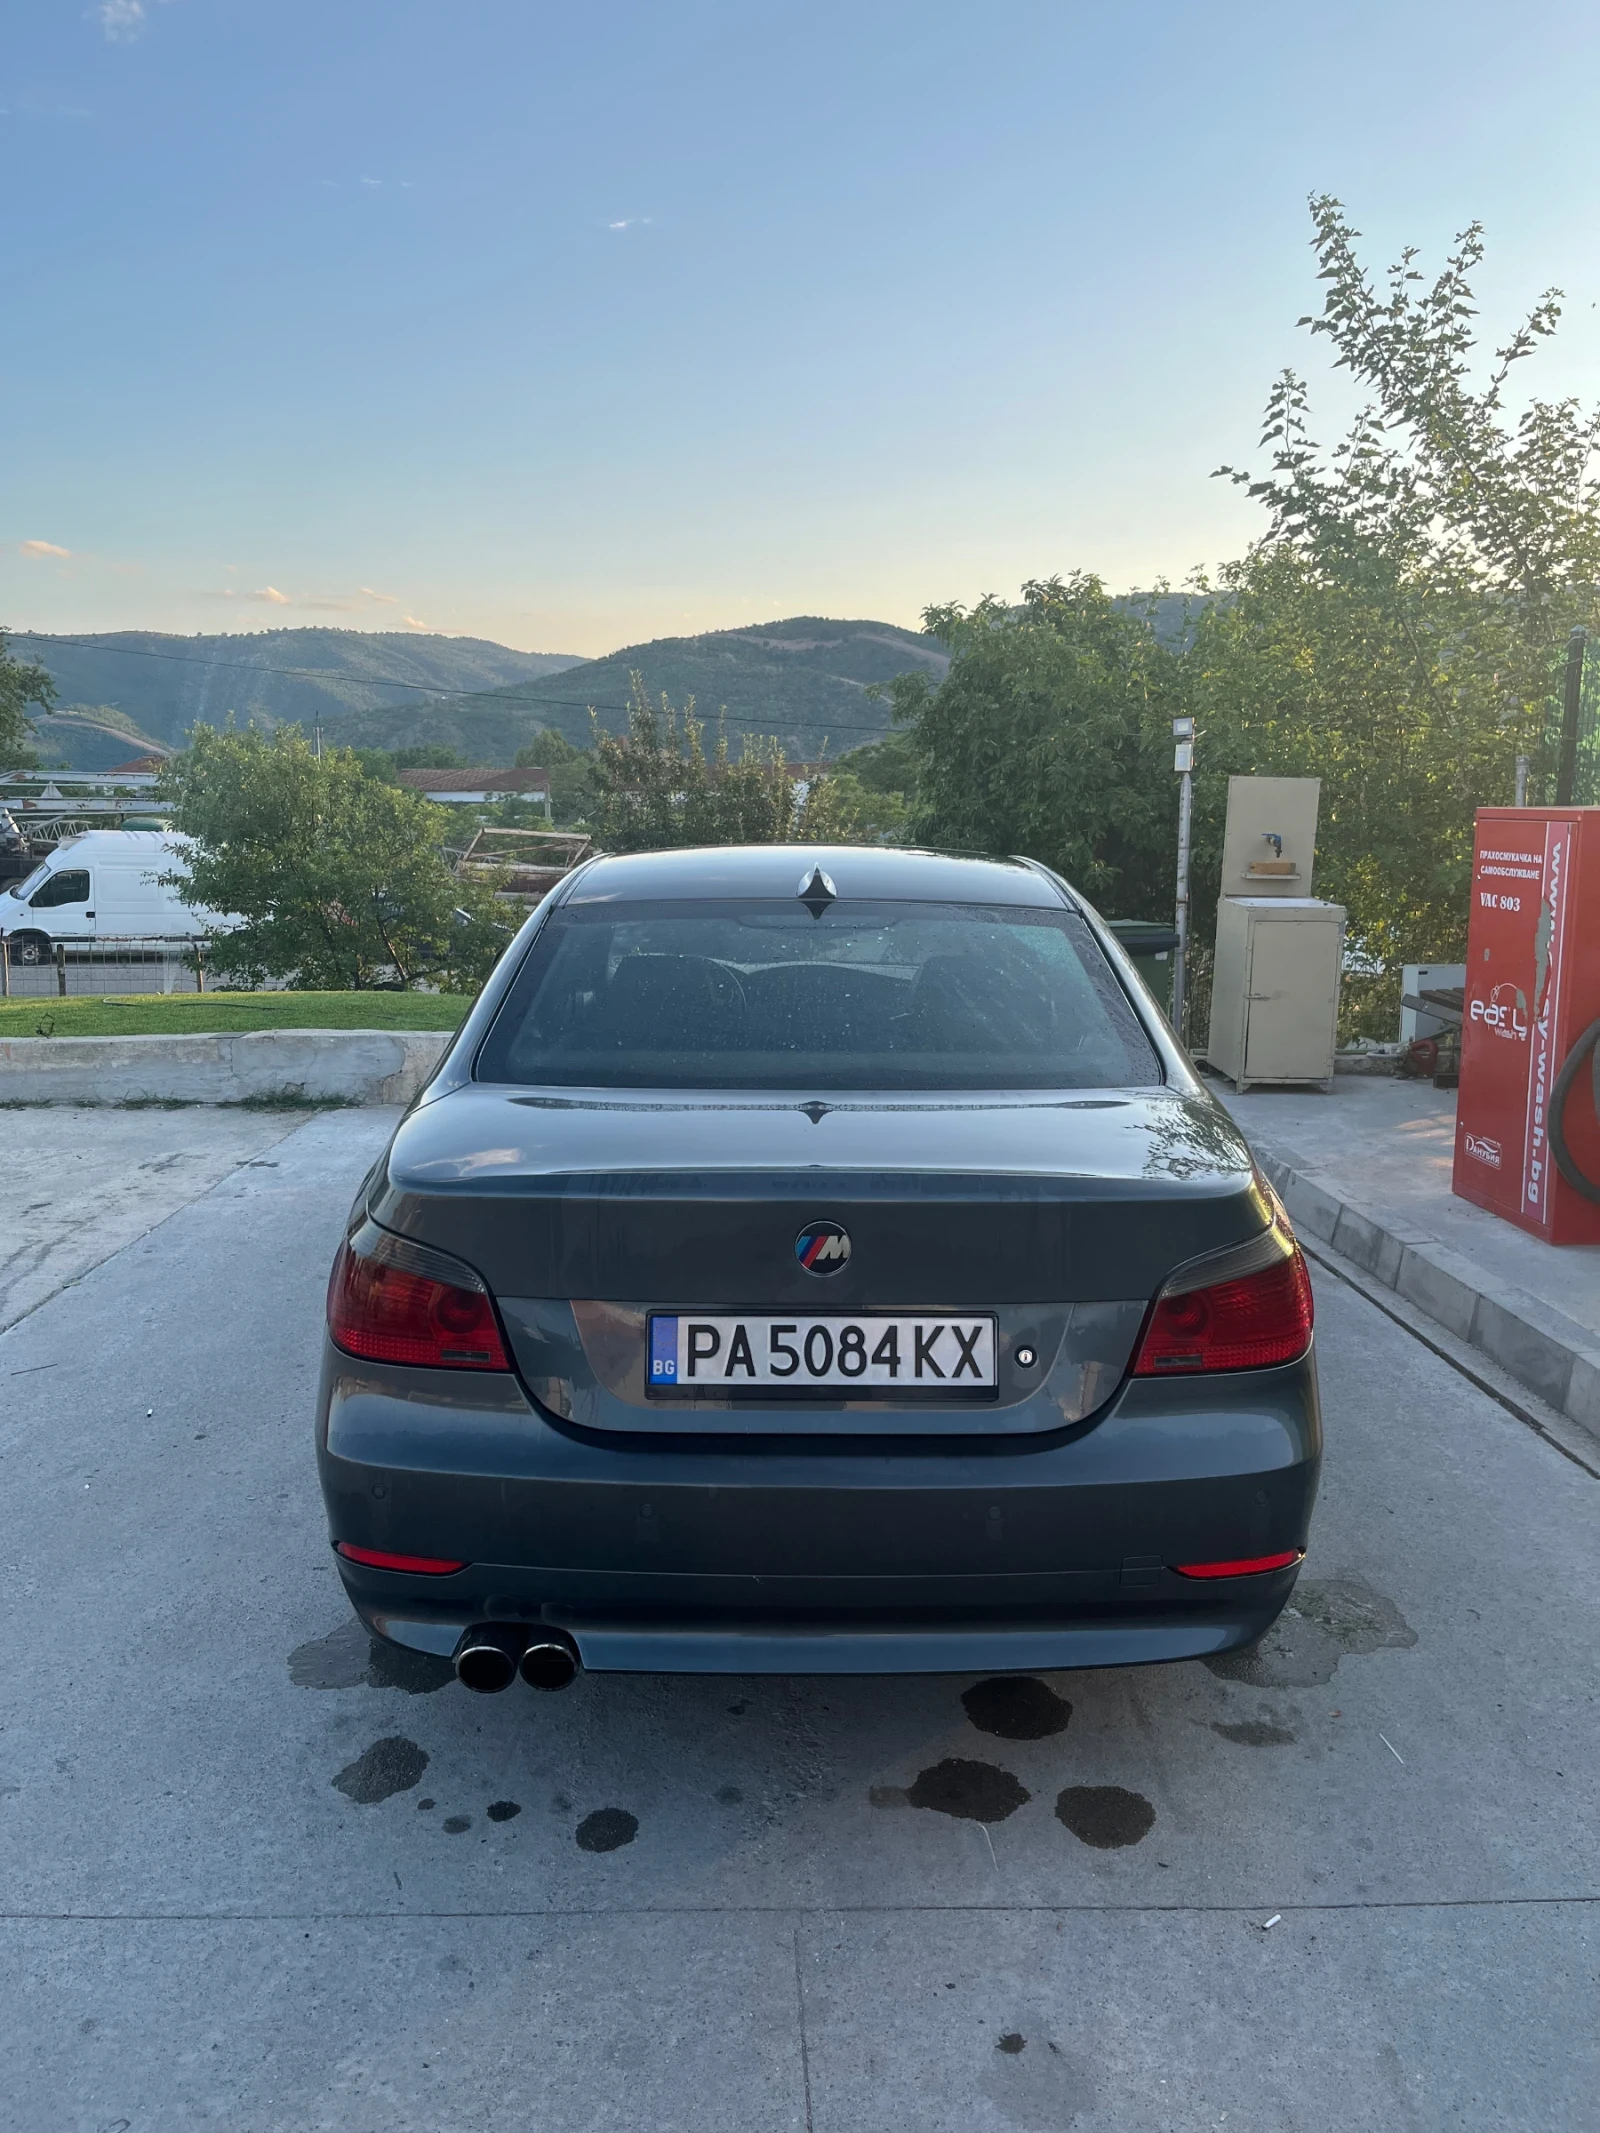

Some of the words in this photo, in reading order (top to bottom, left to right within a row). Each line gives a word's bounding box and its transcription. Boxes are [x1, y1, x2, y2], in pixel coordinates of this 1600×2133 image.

[1480, 850, 1533, 863] ПРАХОСМУКАЧКА
[1533, 854, 1543, 864] НА
[1480, 865, 1540, 880] САМООБСЛУЖВАНЕ
[1480, 892, 1498, 908] VAC
[1500, 896, 1520, 912] 803
[652, 1360, 676, 1376] BG
